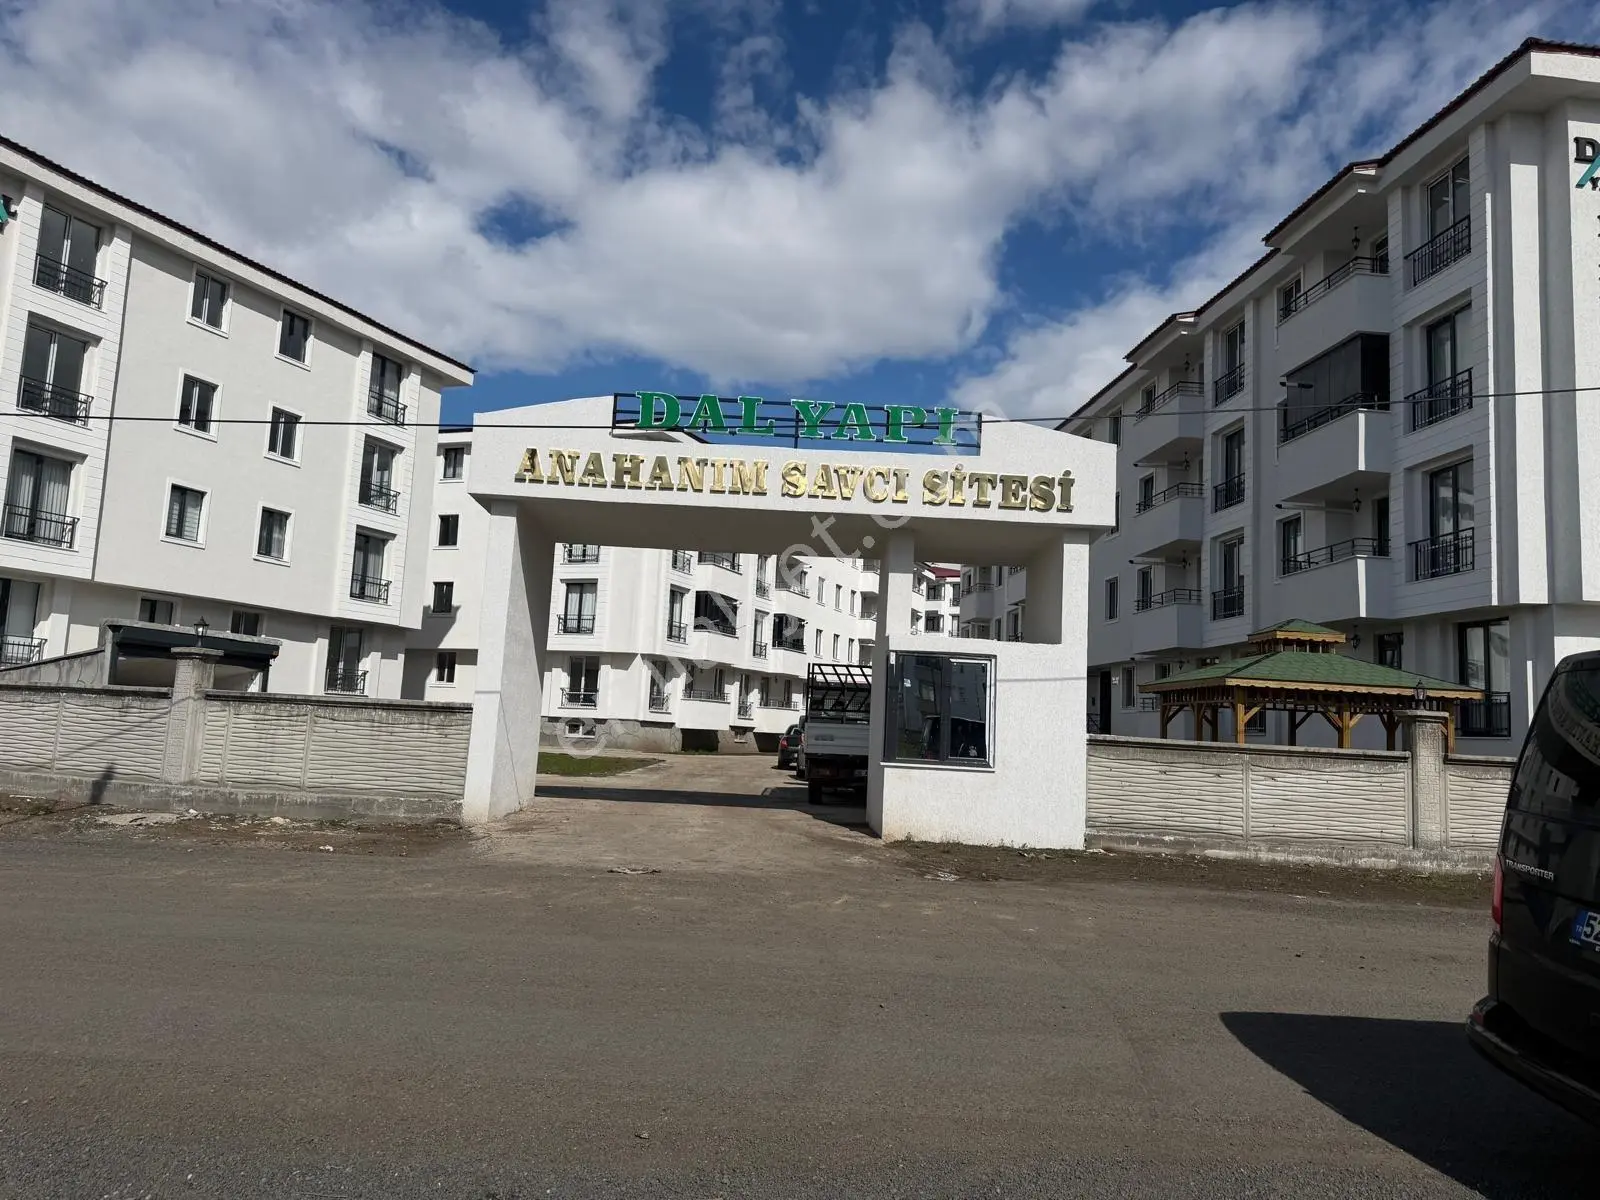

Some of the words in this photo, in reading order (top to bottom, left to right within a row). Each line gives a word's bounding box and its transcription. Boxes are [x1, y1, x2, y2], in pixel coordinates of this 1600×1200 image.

[636, 390, 778, 436] DAL
[791, 398, 960, 446] YAPI
[514, 447, 769, 496] ANAHANIM
[780, 459, 911, 503] SAVCI
[922, 462, 1075, 513] SİTESİ
[1505, 859, 1554, 881] TRANSPORTER
